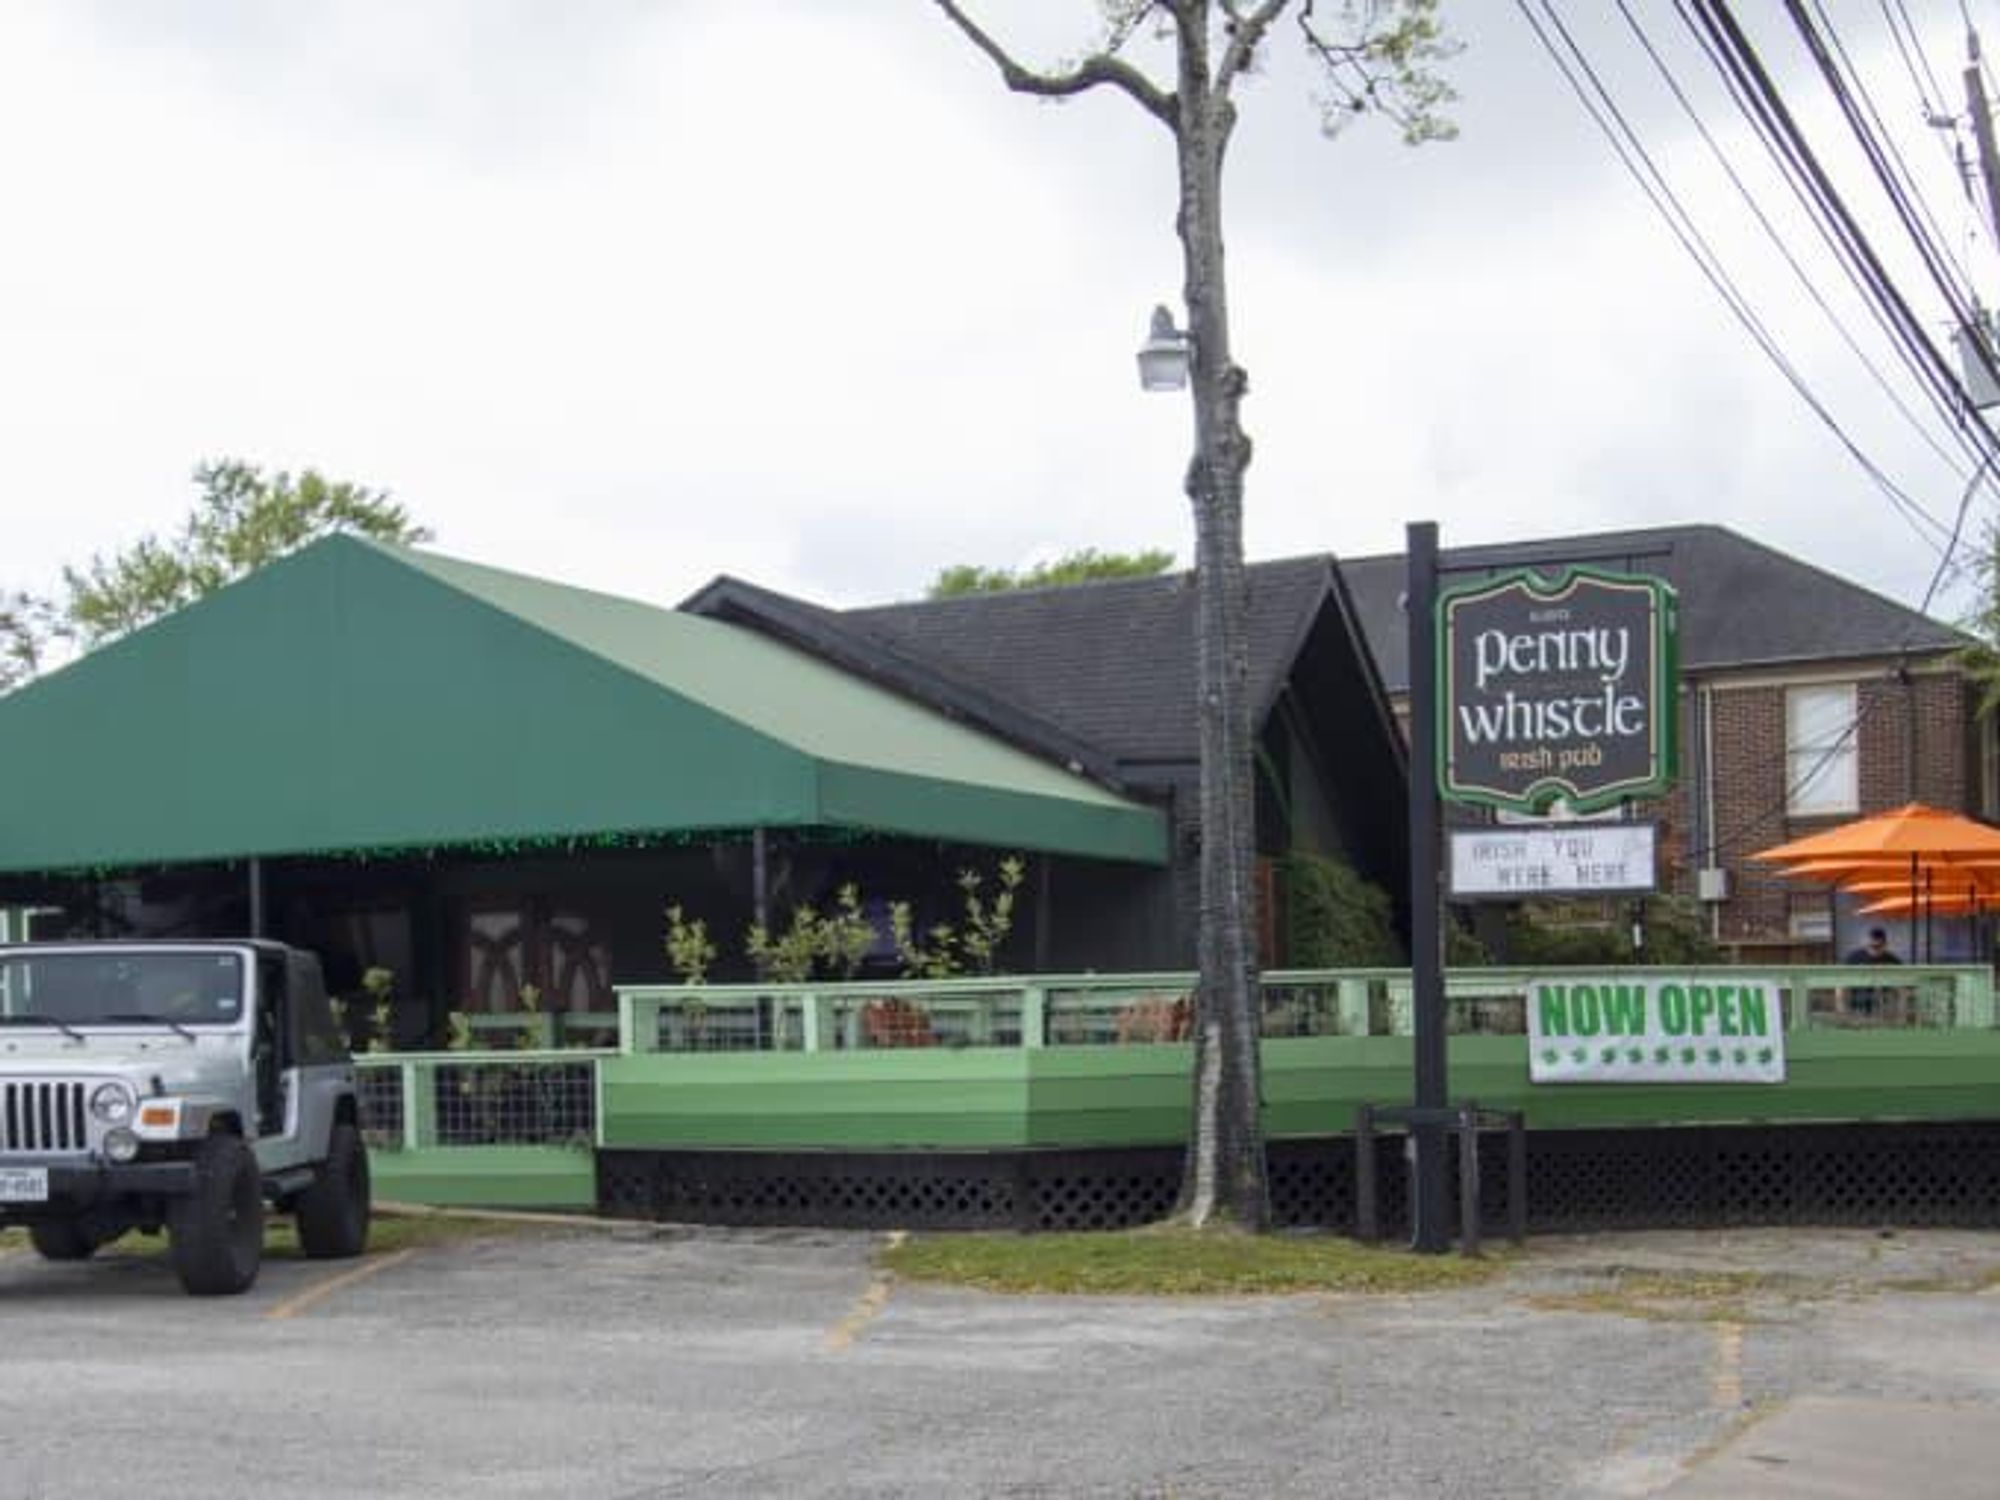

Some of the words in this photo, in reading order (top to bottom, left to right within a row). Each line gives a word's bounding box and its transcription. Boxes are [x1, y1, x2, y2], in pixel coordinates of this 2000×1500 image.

[1474, 627, 1629, 689] penny
[1459, 684, 1645, 743] whistle
[1553, 837, 1594, 860] YOU
[1538, 984, 1646, 1036] NOW
[1657, 984, 1767, 1036] OPEN
